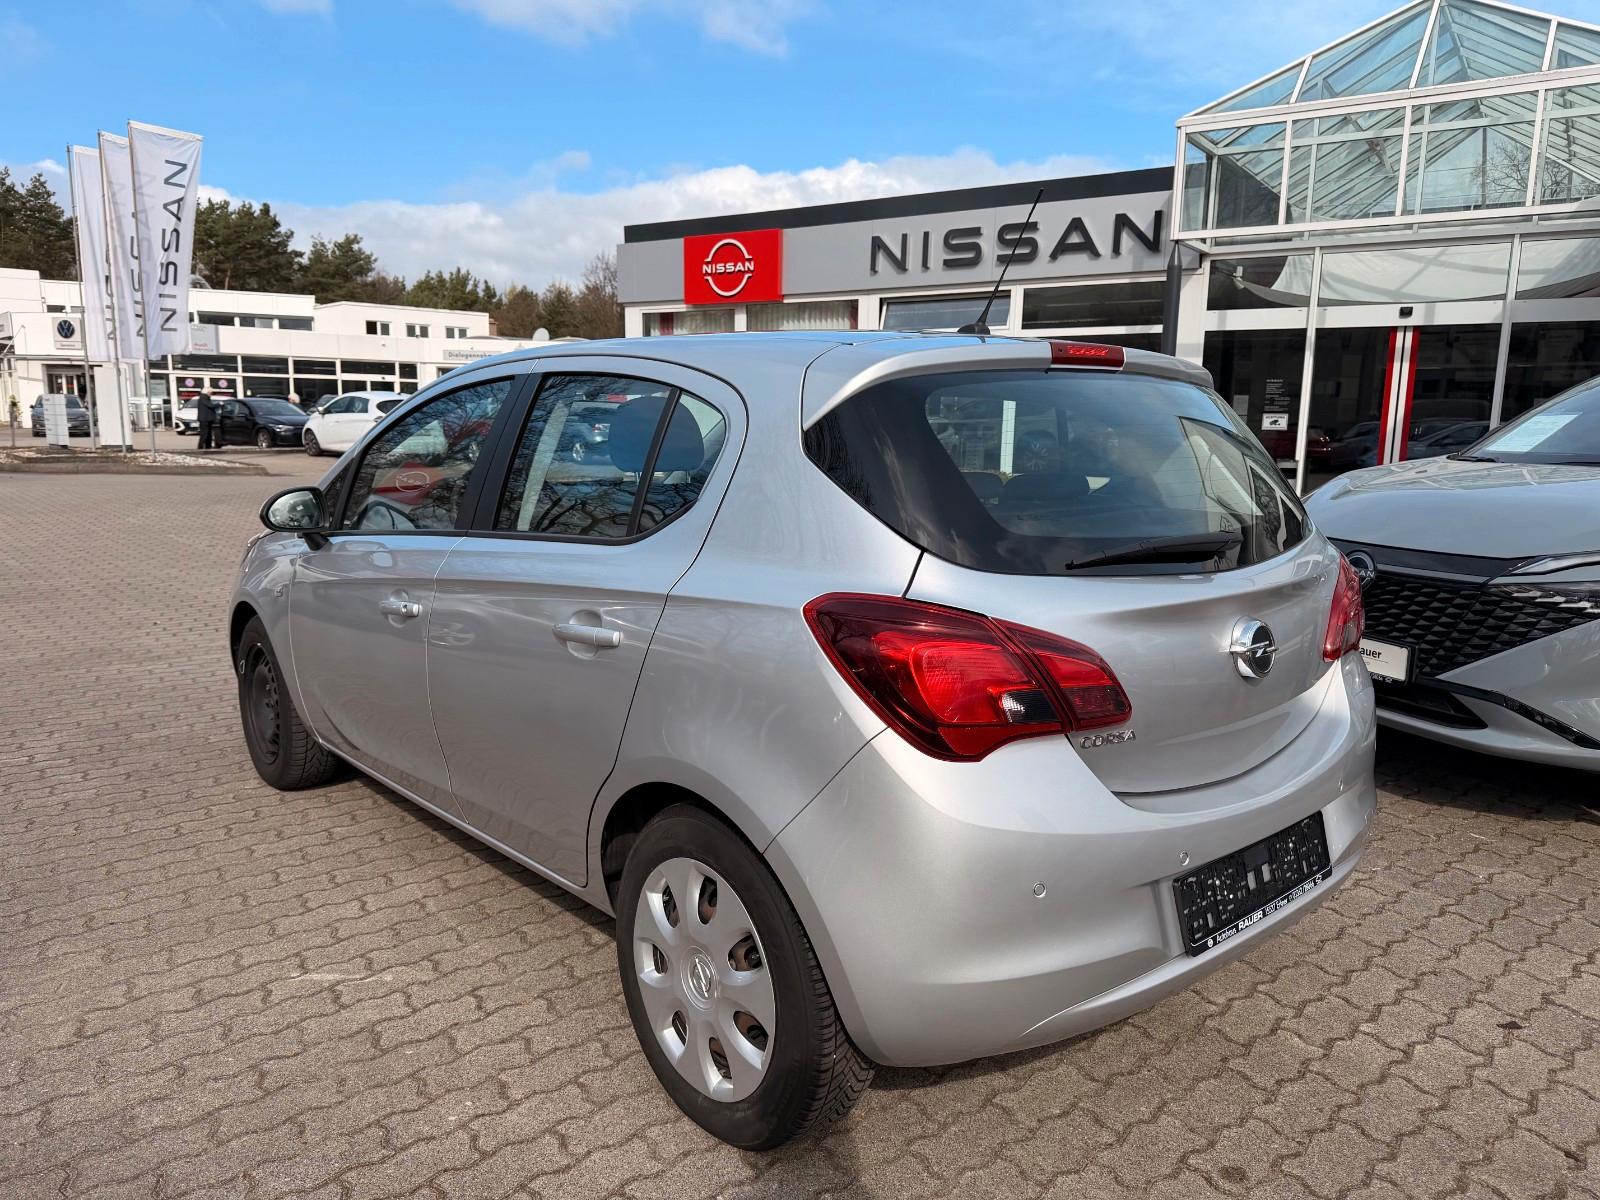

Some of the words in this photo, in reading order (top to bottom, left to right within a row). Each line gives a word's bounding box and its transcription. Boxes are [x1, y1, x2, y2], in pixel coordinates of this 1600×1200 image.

[158, 159, 188, 332] NISSAN
[869, 209, 1164, 274] NISSAN
[702, 260, 755, 275] NISSAN
[1359, 647, 1383, 660] auer
[1080, 729, 1137, 749] CORSA
[1239, 911, 1263, 930] RAUER
